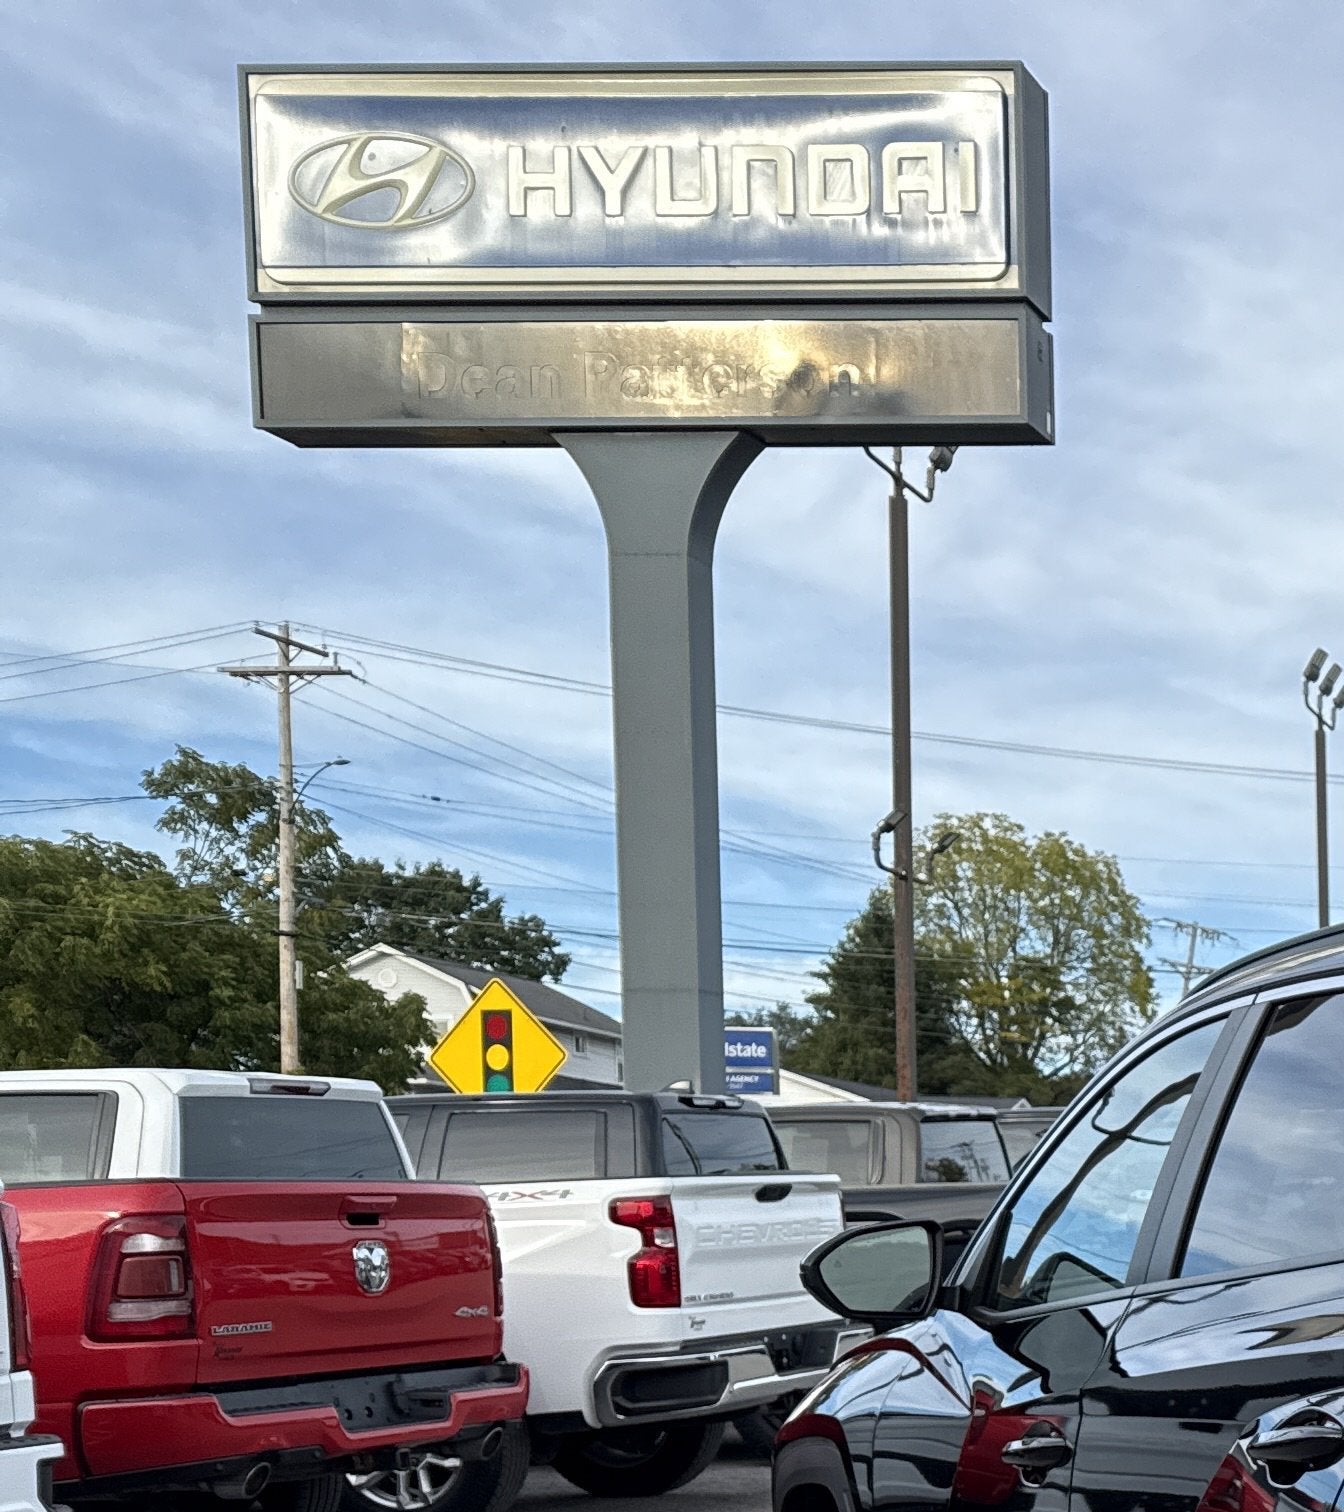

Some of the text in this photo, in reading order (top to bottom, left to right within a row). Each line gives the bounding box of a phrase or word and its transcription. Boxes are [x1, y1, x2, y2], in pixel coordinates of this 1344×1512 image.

[507, 140, 980, 219] HYUNDAI
[417, 351, 862, 399] Dean Patterson
[724, 1041, 767, 1058] lstate
[211, 1321, 272, 1335] LARAMIE
